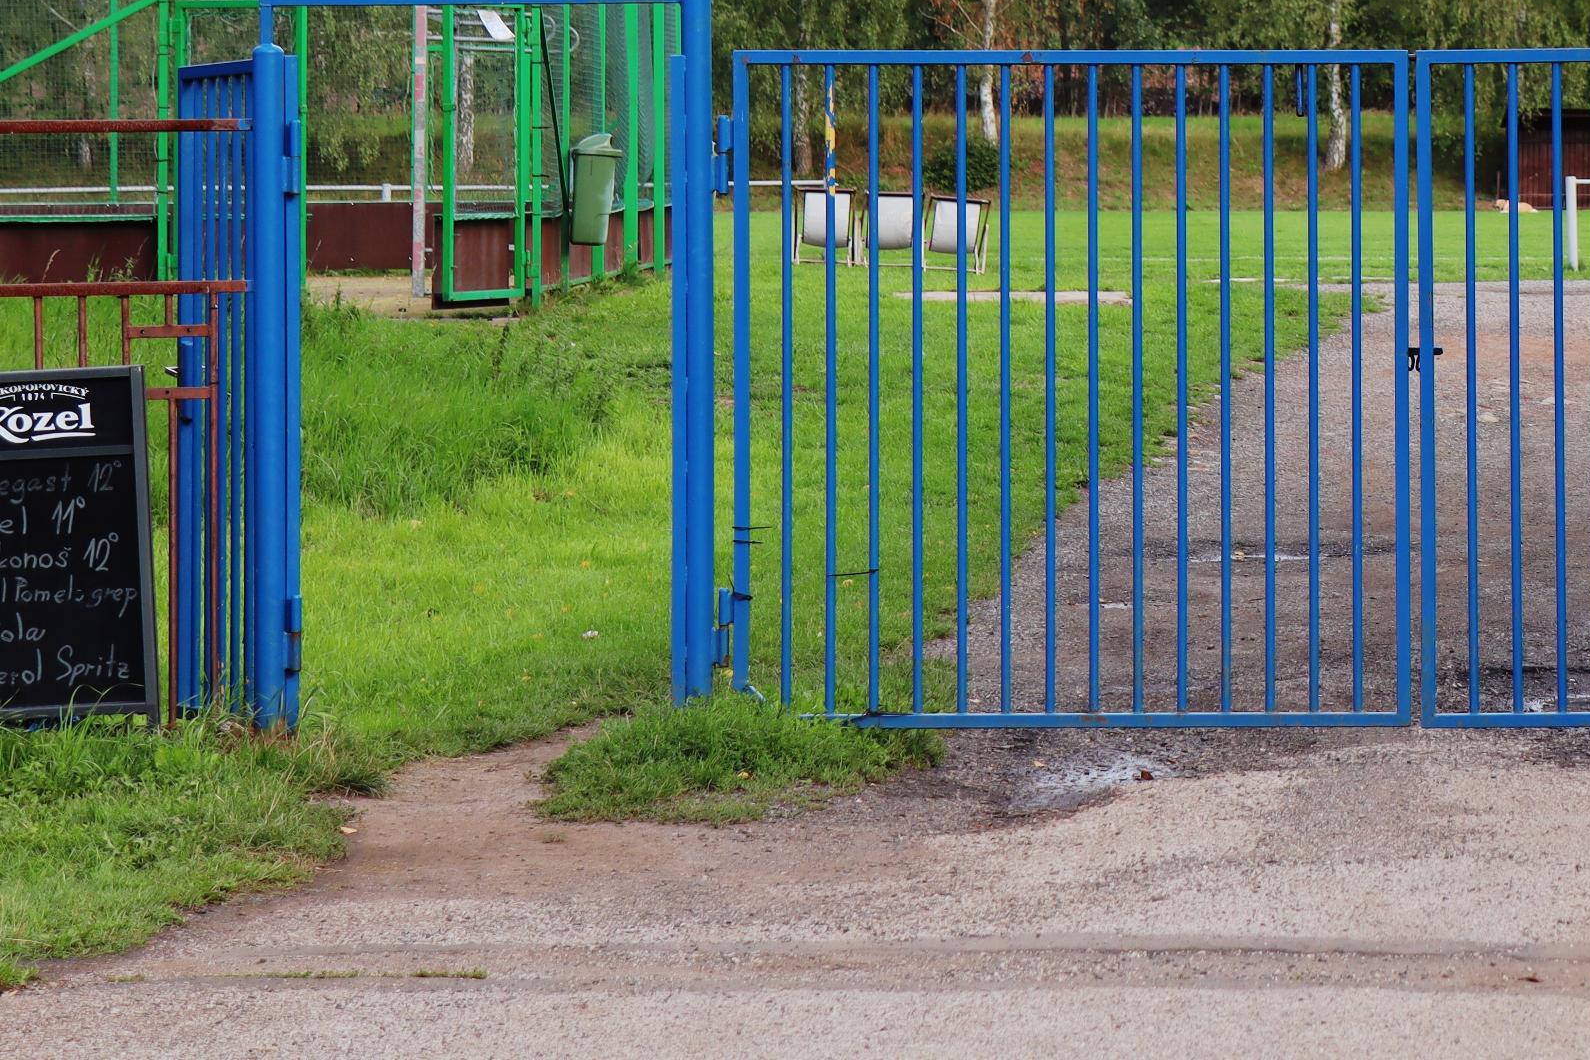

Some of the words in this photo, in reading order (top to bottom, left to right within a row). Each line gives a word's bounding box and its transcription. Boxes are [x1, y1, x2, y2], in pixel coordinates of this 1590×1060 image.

[21, 392, 45, 401] 1874
[86, 587, 138, 618] grep
[56, 644, 129, 687] Spritz
